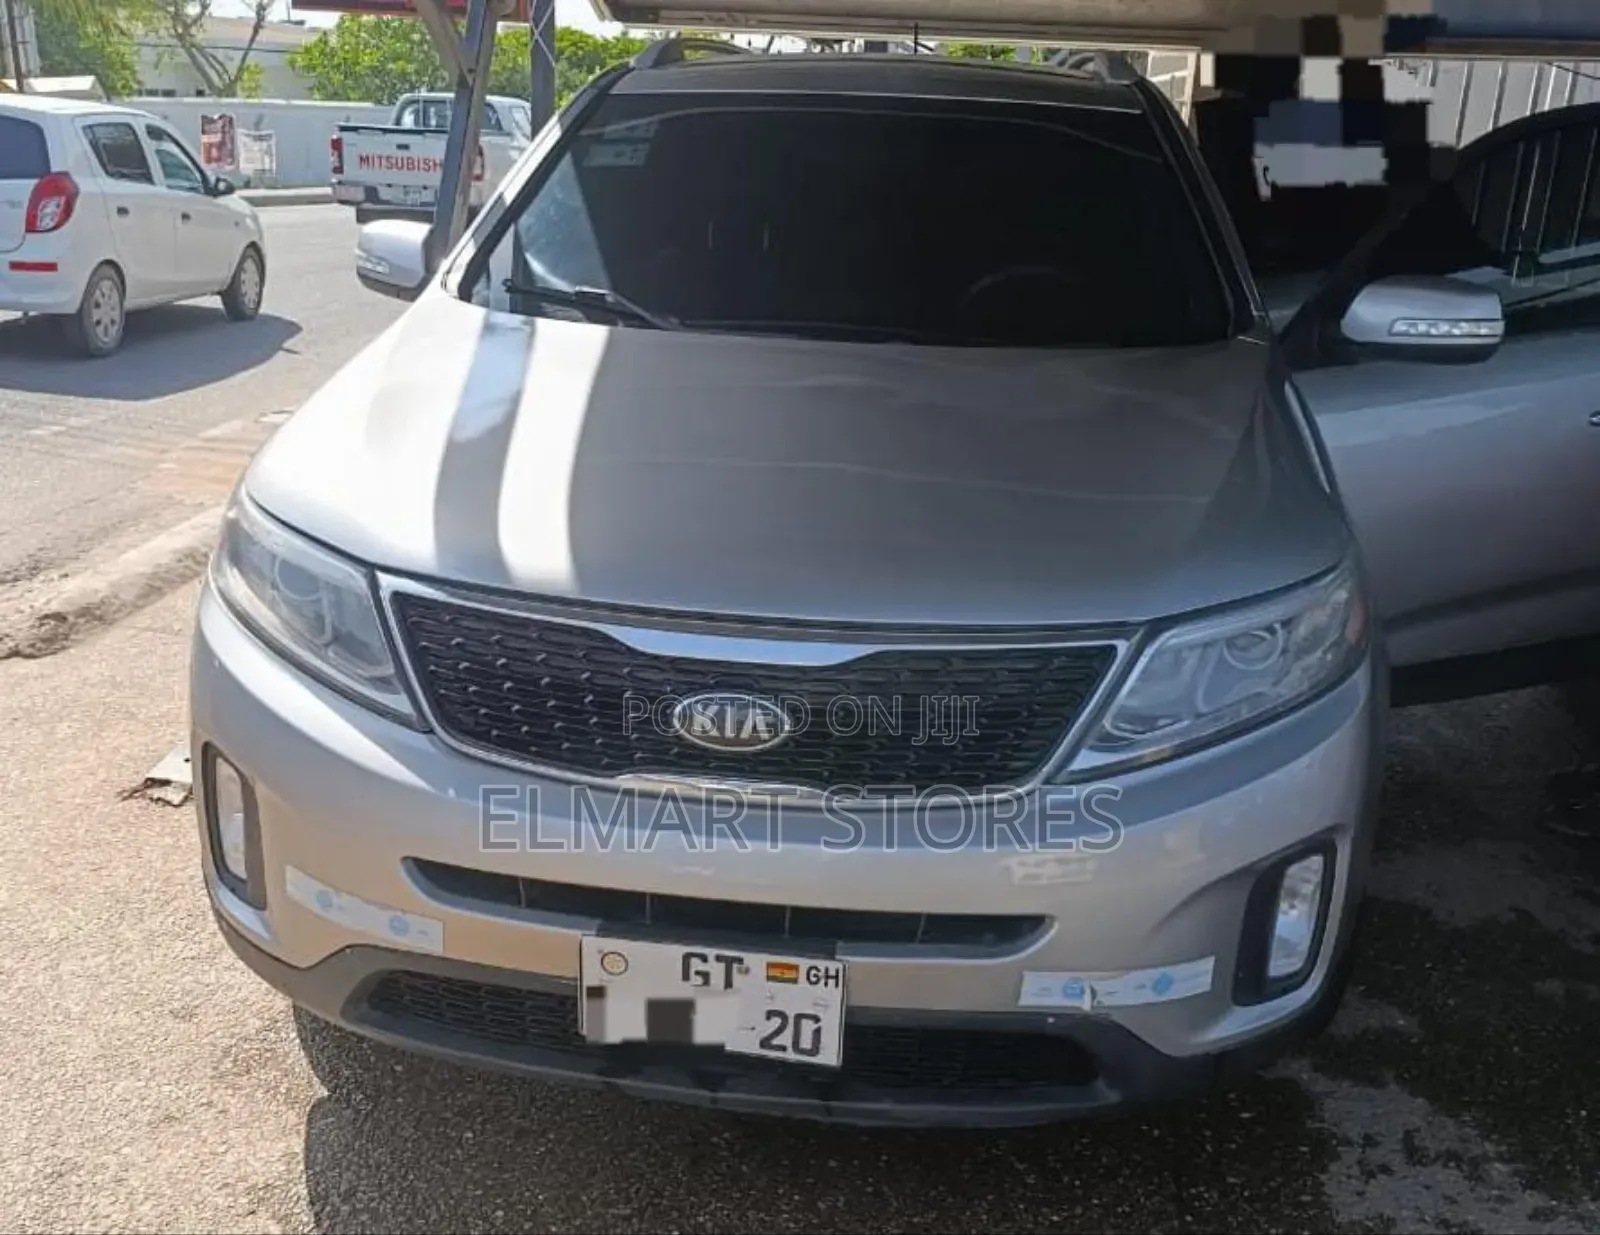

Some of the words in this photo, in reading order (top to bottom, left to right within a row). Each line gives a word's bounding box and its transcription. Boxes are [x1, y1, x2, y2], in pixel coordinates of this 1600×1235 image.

[359, 153, 445, 173] MITSUBISH
[692, 704, 770, 741] KIA
[681, 951, 744, 990] GT
[805, 965, 840, 989] GH
[758, 1008, 822, 1058] 20
